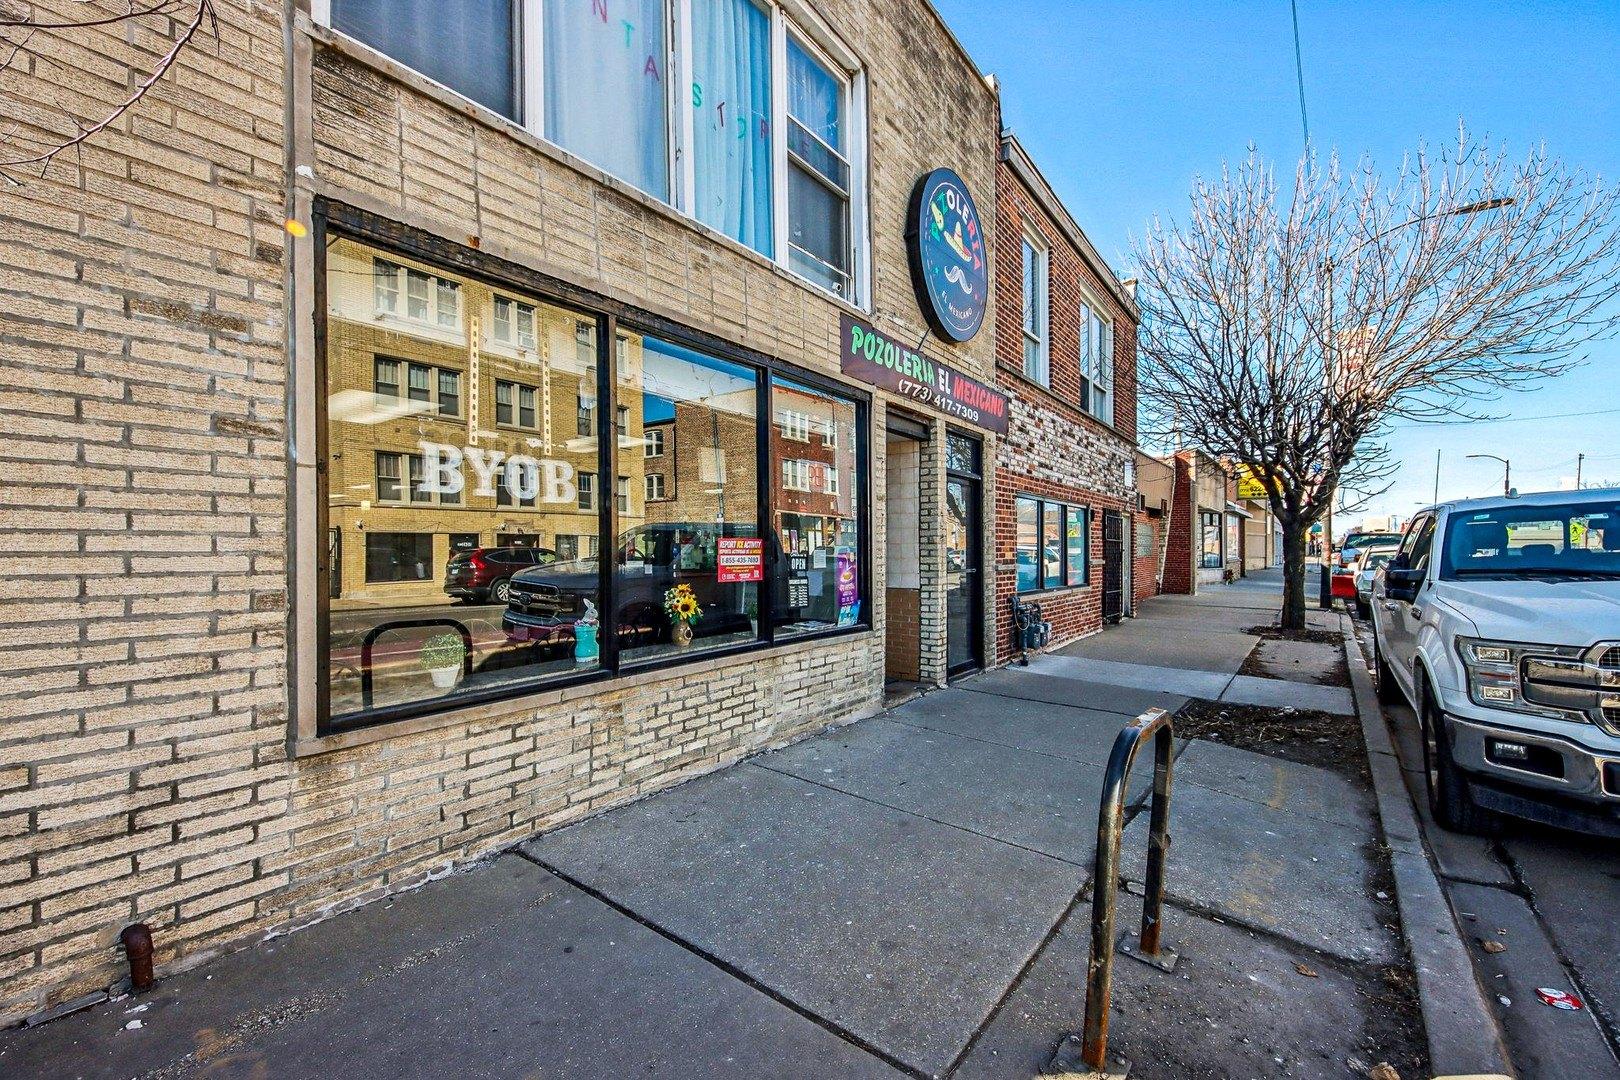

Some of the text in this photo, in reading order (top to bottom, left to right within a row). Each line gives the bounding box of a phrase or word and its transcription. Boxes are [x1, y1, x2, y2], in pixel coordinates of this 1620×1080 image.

[850, 324, 1004, 418] POZOLERIA EL MEXICANO
[898, 378, 979, 423] (773) 417-7309
[418, 441, 576, 502] BYOB
[791, 558, 806, 570] OPEN
